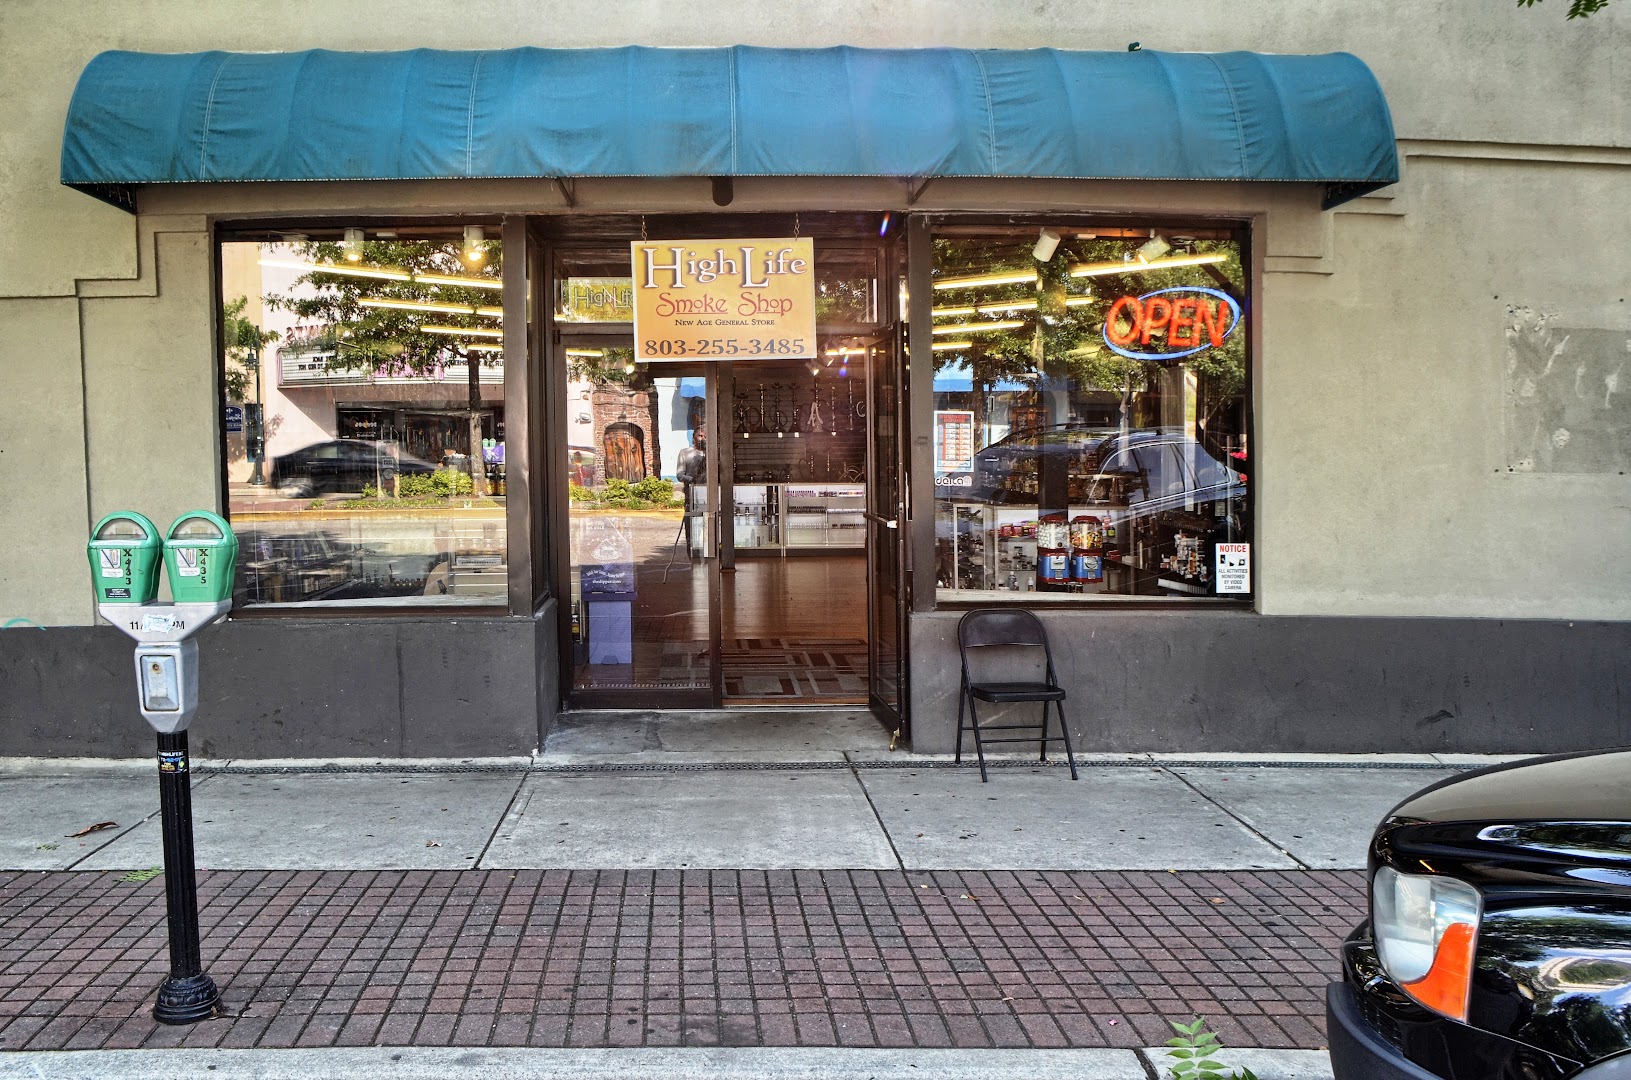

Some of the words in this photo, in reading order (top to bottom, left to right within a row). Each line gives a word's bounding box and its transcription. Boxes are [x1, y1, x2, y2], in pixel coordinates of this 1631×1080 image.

[656, 292, 728, 317] Smoke
[738, 291, 793, 317] Shop
[1106, 296, 1229, 348] OPEN
[645, 338, 805, 356] 803-255-3485
[1219, 544, 1247, 553] NOTICE
